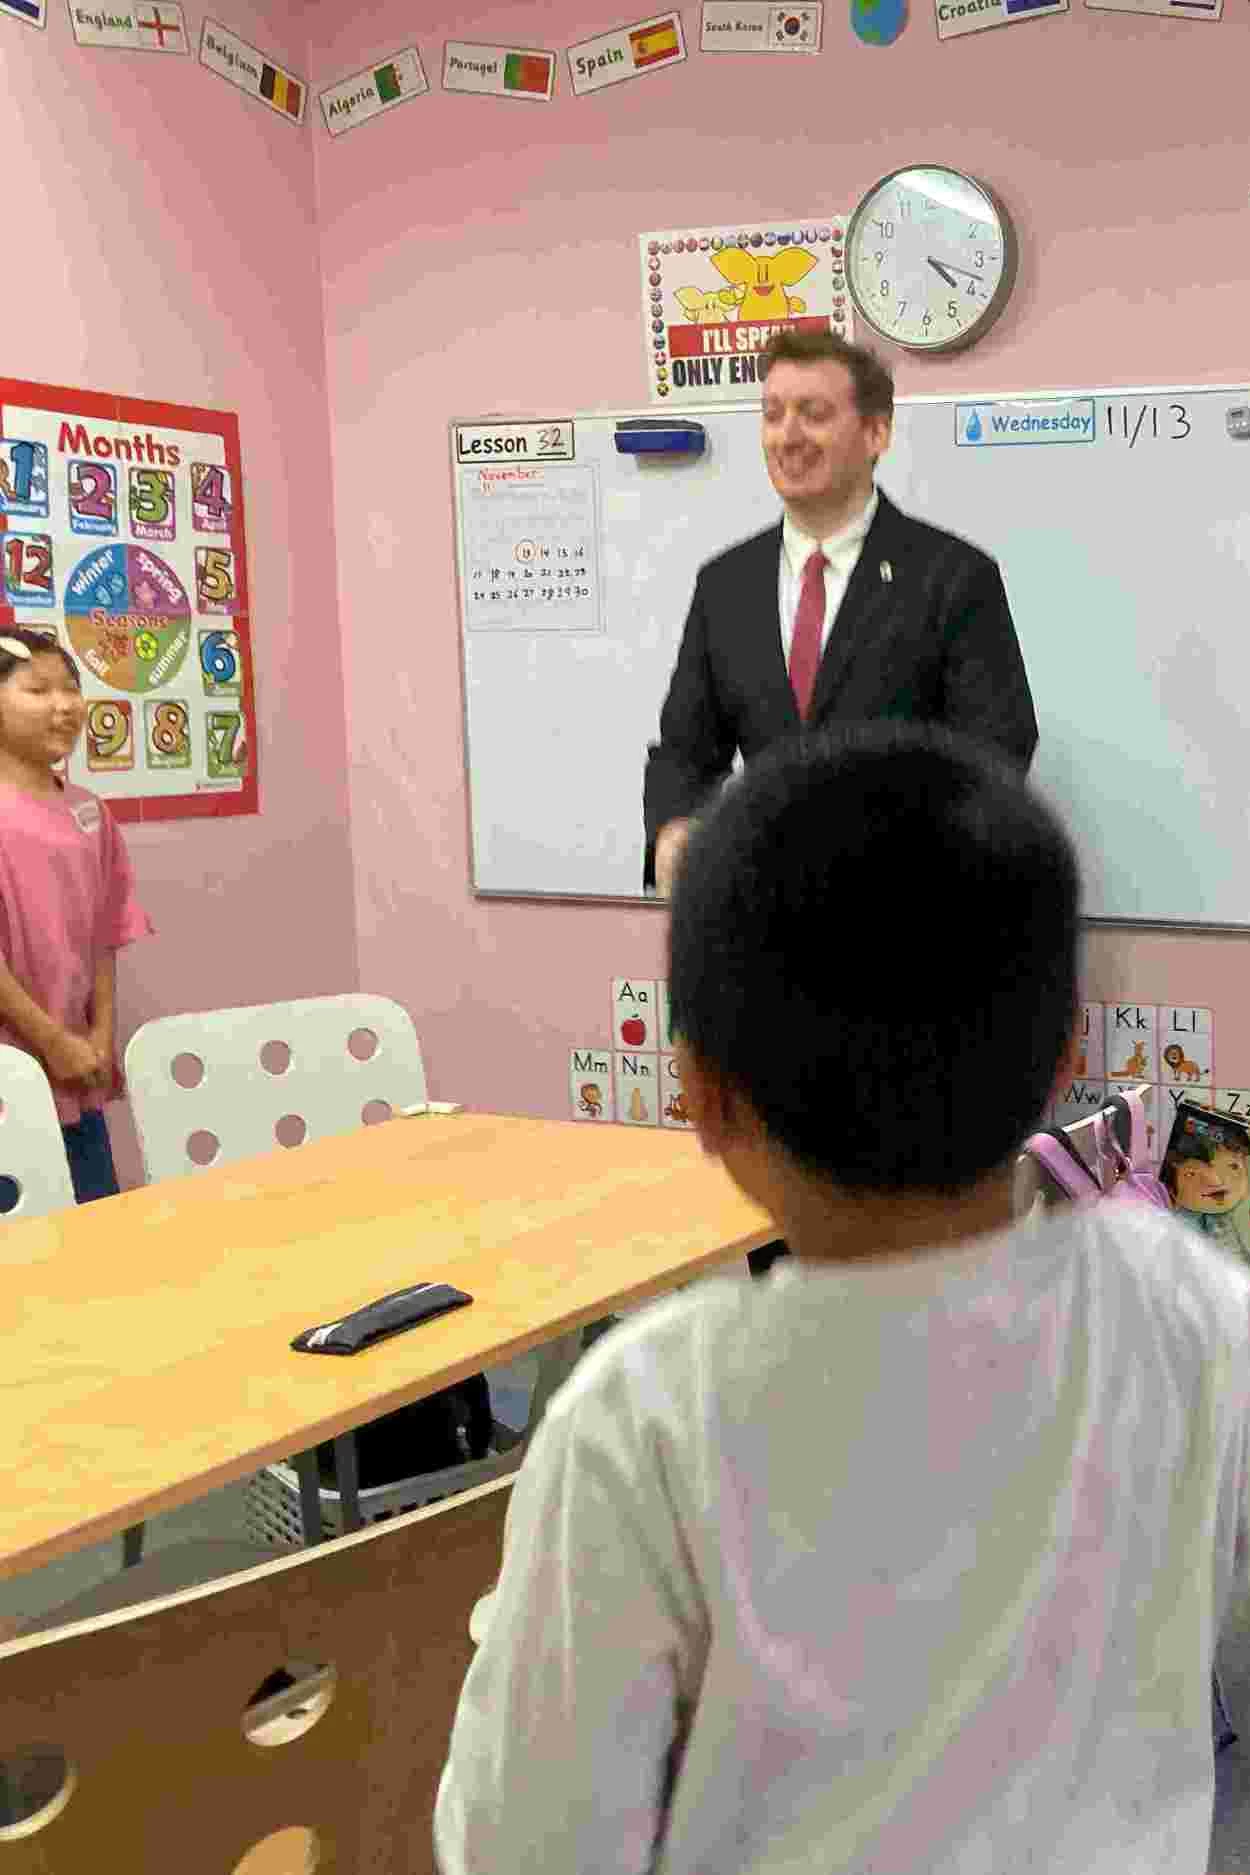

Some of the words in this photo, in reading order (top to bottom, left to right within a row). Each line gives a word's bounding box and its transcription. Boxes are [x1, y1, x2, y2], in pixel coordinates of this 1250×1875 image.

[75, 9, 133, 31] England
[705, 22, 732, 32] South
[735, 22, 763, 33] Korea
[205, 33, 260, 79] Belgium
[449, 57, 498, 75] Portugal
[576, 47, 624, 77] Spain
[328, 87, 376, 118] Algeria
[879, 222, 895, 240] 10
[967, 223, 977, 240] 2
[873, 250, 884, 268] 9
[974, 250, 984, 268] 3
[879, 280, 890, 297] 8
[966, 280, 977, 296] 4
[897, 301, 907, 317] 7
[922, 309, 932, 326] 6
[947, 301, 958, 318] 5
[672, 357, 722, 388] ONLY
[992, 413, 1092, 437] Wednesday
[57, 421, 181, 467] Months
[459, 432, 528, 455] Lesson
[536, 427, 565, 450] 32
[77, 463, 113, 519] 2
[136, 470, 170, 523] 3
[198, 464, 226, 517] 4
[5, 539, 49, 589] 12
[200, 550, 234, 603] 5
[199, 630, 236, 683] 6
[89, 701, 129, 758] 9
[152, 702, 188, 753] 8
[619, 981, 649, 1003] Aa
[1115, 1007, 1149, 1030] Kk
[573, 1052, 608, 1074] Mm
[622, 1055, 649, 1076] Nn
[1168, 1089, 1185, 1113] Y
